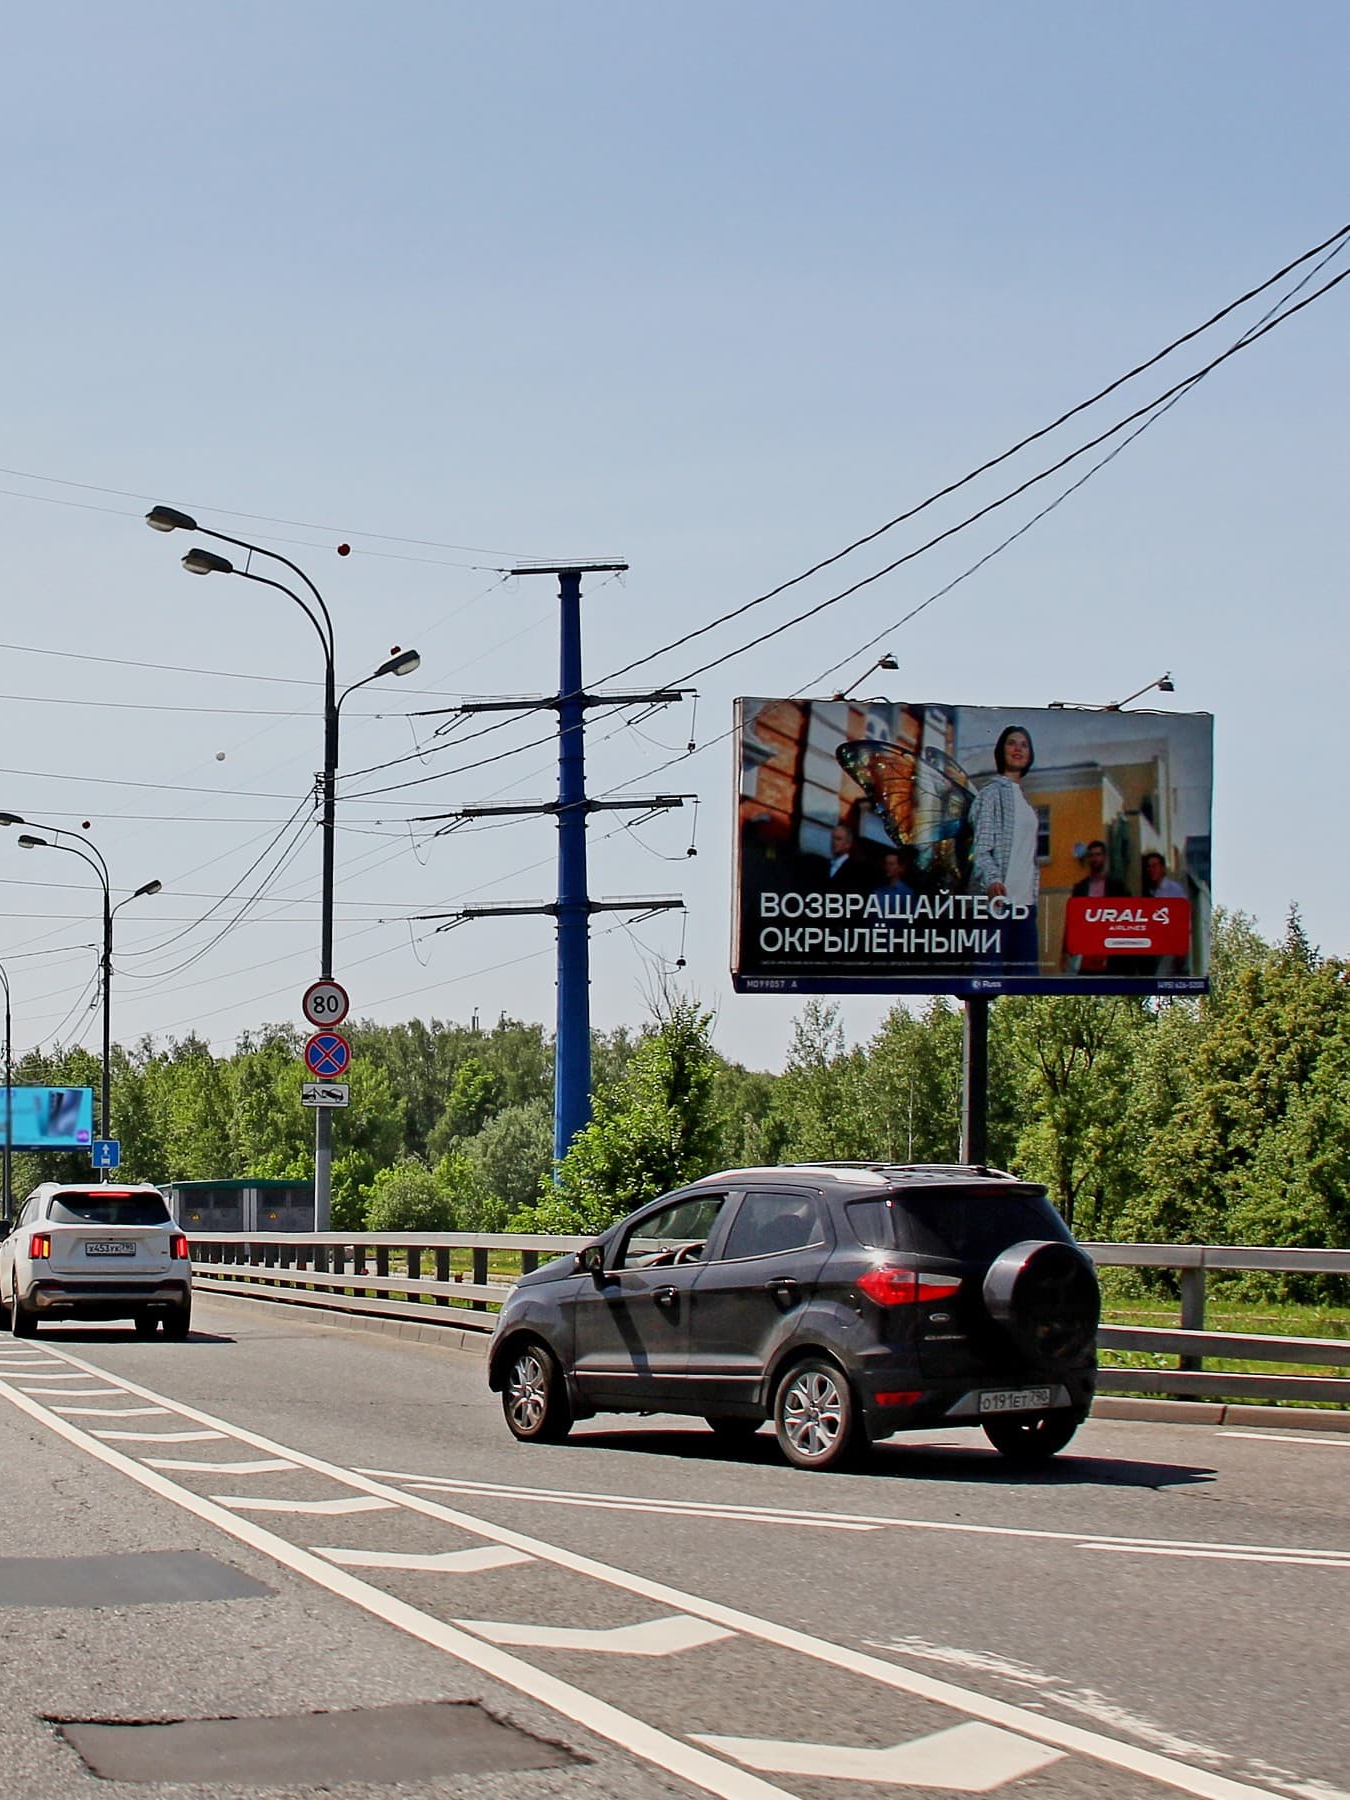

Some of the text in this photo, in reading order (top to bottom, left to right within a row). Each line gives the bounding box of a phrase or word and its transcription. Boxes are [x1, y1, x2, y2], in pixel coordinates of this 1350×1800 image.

[760, 889, 1030, 924] ВОЗВРАЩАЙТЕСЬ
[1084, 908, 1149, 923] URAL
[759, 923, 1001, 954] ОКРЫЛЁННЫМИ
[313, 995, 339, 1014] 80
